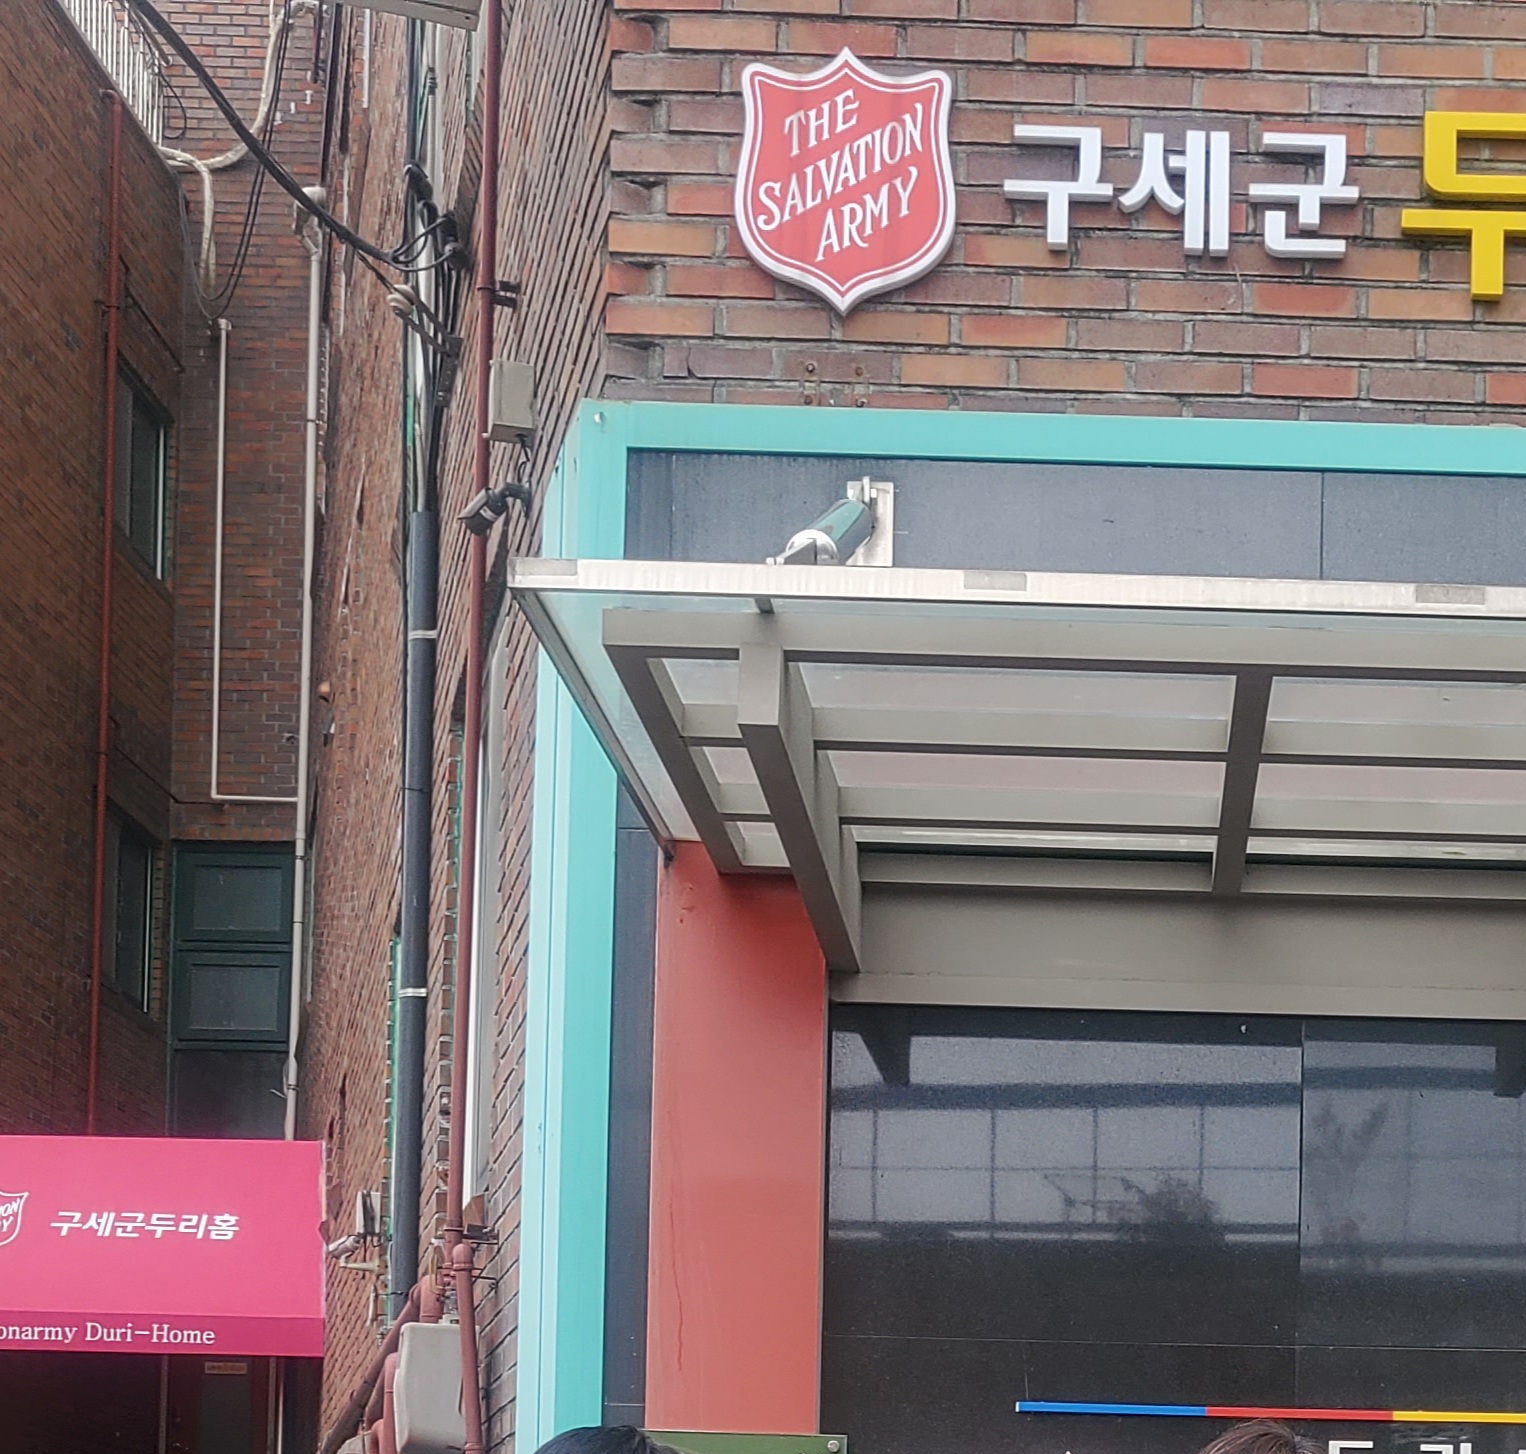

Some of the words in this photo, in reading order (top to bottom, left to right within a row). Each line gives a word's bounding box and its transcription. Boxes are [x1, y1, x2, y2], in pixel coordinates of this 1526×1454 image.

[784, 88, 860, 158] THE
[757, 102, 923, 231] SALVATION
[1004, 123, 1360, 259] 구세군
[815, 166, 919, 262] ARMY
[50, 1211, 240, 1240] 구세군두리홈
[85, 1322, 215, 1345] Duri-Home
